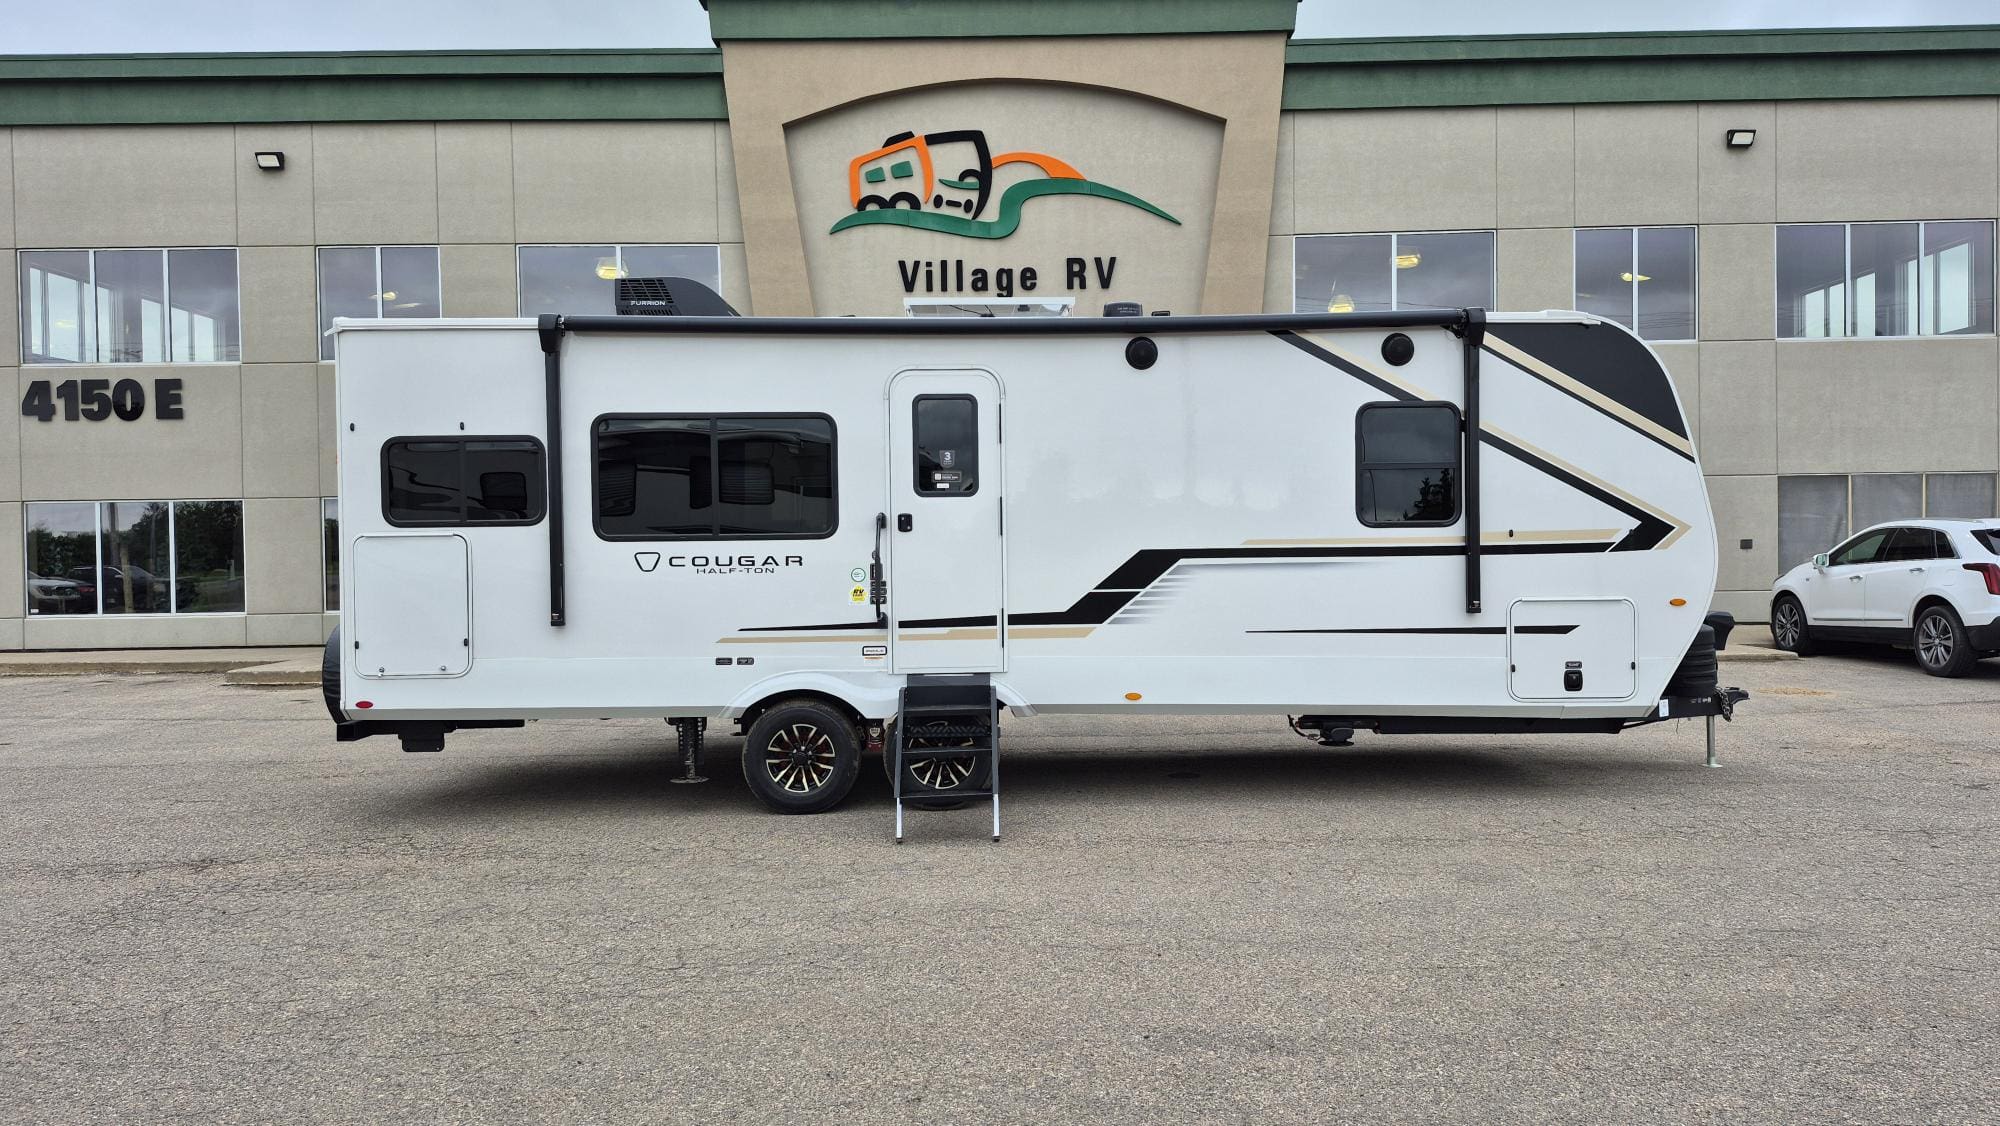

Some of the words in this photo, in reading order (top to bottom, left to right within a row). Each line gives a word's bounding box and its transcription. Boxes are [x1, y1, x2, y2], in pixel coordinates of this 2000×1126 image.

[897, 259, 1038, 298] Village
[1066, 256, 1117, 290] RV
[21, 378, 146, 422] 4150
[154, 378, 184, 420] E
[943, 451, 952, 461] 3
[668, 555, 804, 568] COUGAR
[696, 567, 775, 575] HALF-TON
